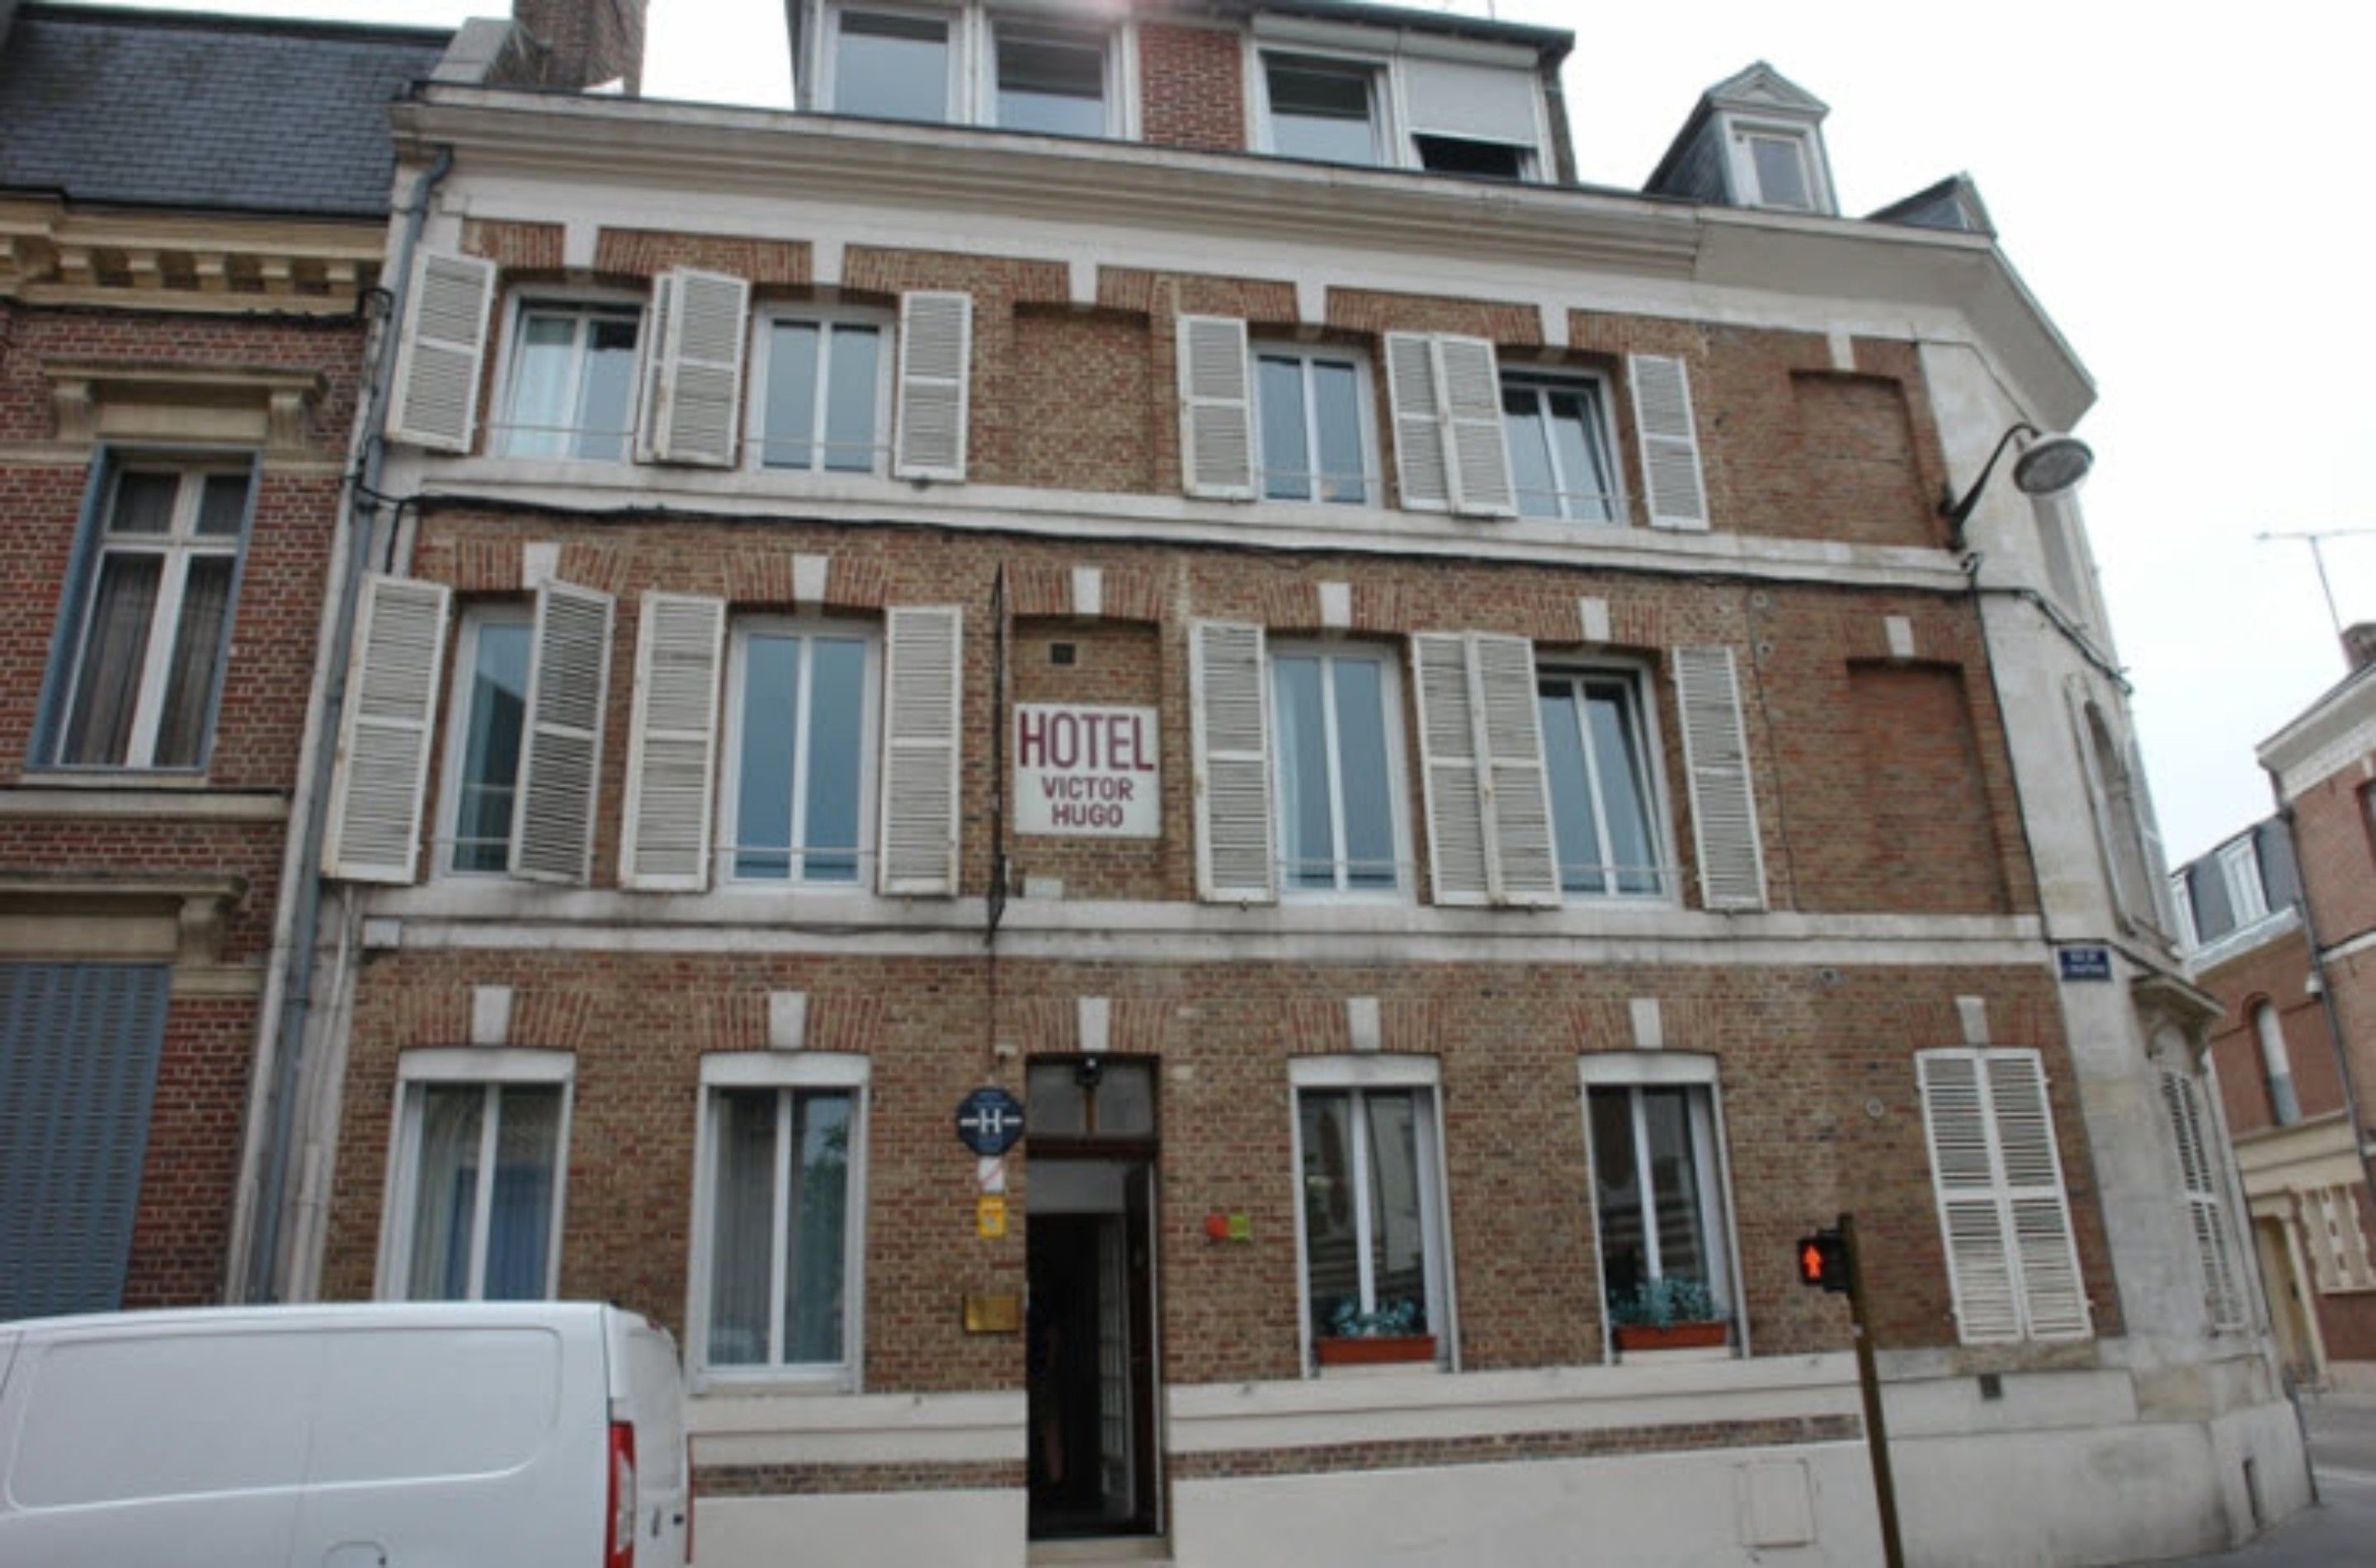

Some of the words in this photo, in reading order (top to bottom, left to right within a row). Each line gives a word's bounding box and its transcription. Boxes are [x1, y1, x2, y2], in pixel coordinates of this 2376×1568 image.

[1020, 711, 1154, 771] HOTEL
[1042, 776, 1134, 801] VICTOR
[1051, 803, 1124, 828] HUGO
